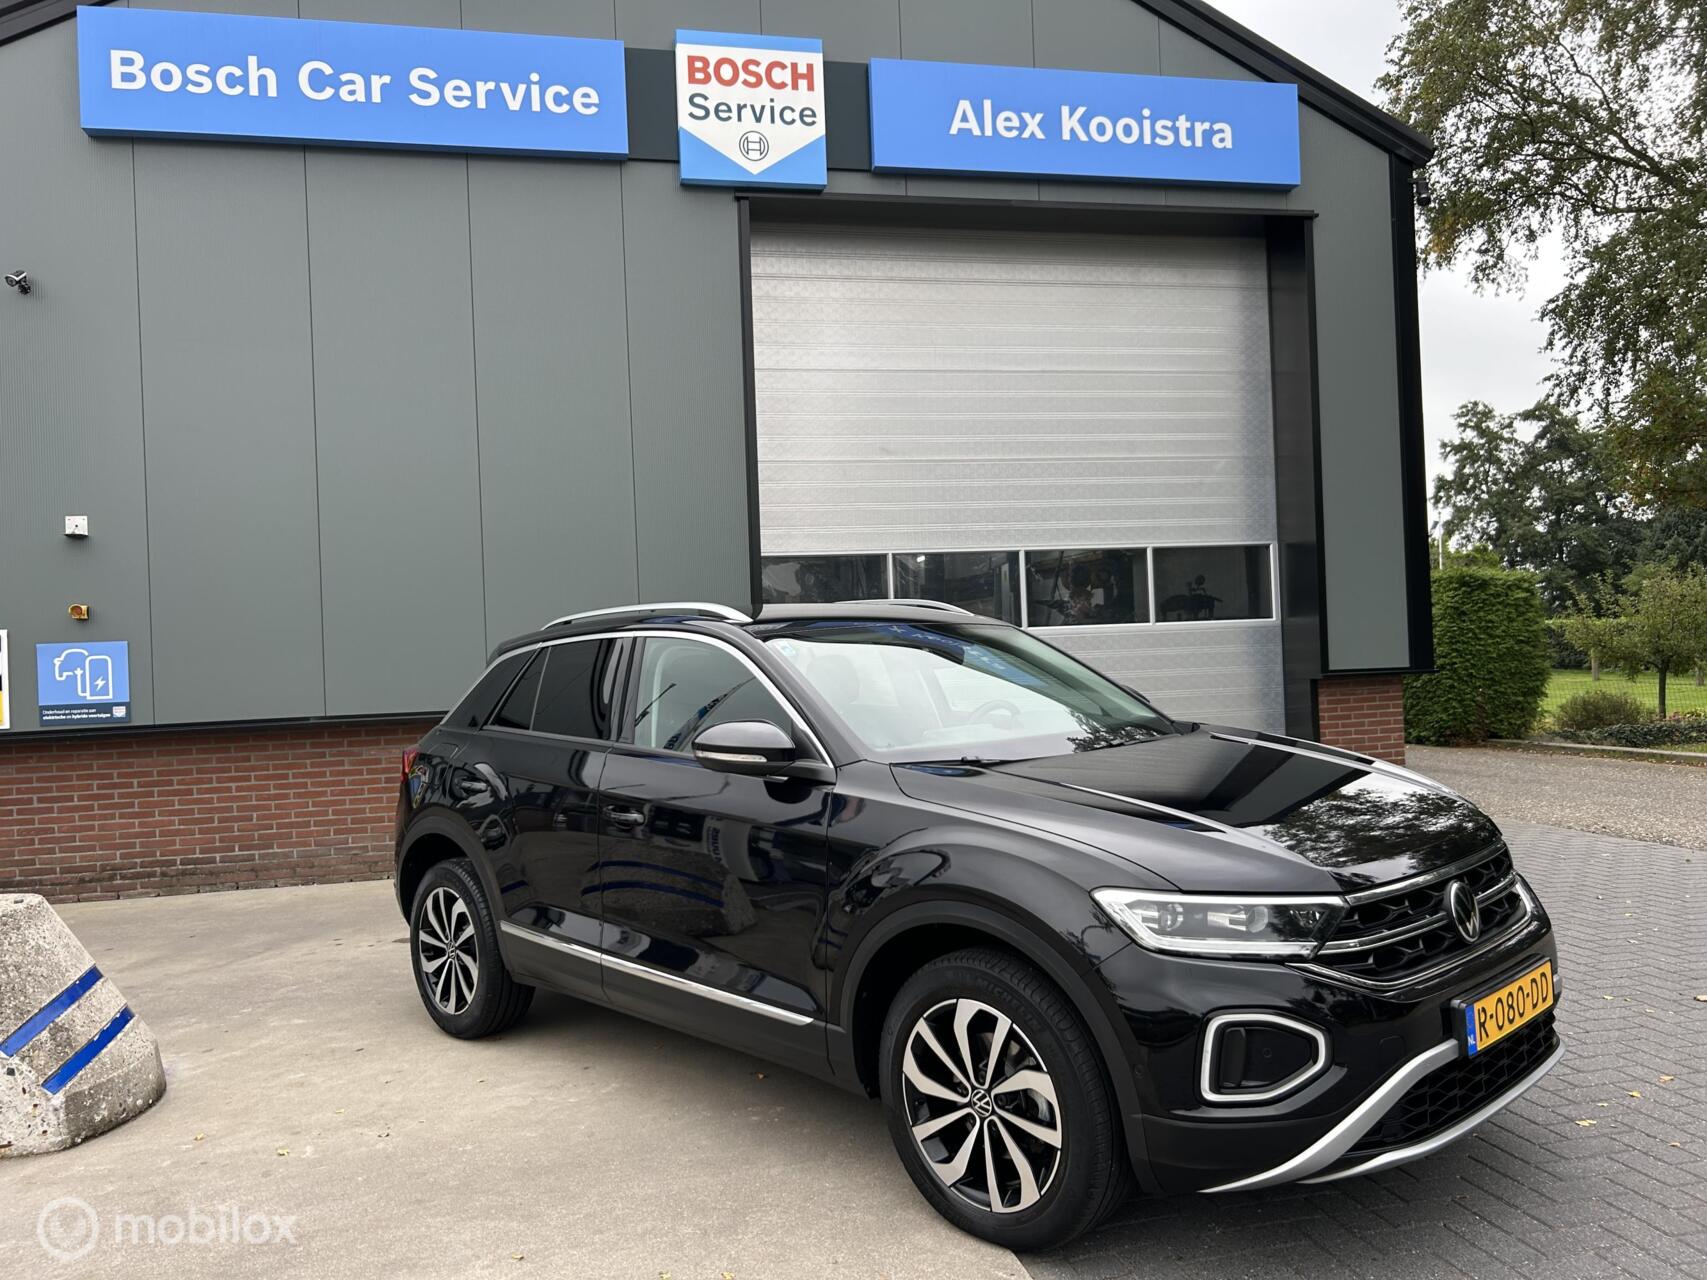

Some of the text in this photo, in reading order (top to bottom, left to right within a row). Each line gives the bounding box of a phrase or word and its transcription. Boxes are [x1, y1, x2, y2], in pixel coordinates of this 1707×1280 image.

[109, 48, 601, 117] Bosch Car Service
[687, 55, 815, 92] BOSCH
[688, 92, 817, 127] Service
[948, 98, 1234, 150] Alex Kooistra
[1478, 972, 1549, 1042] R-080-DD
[1467, 1035, 1476, 1046] NL
